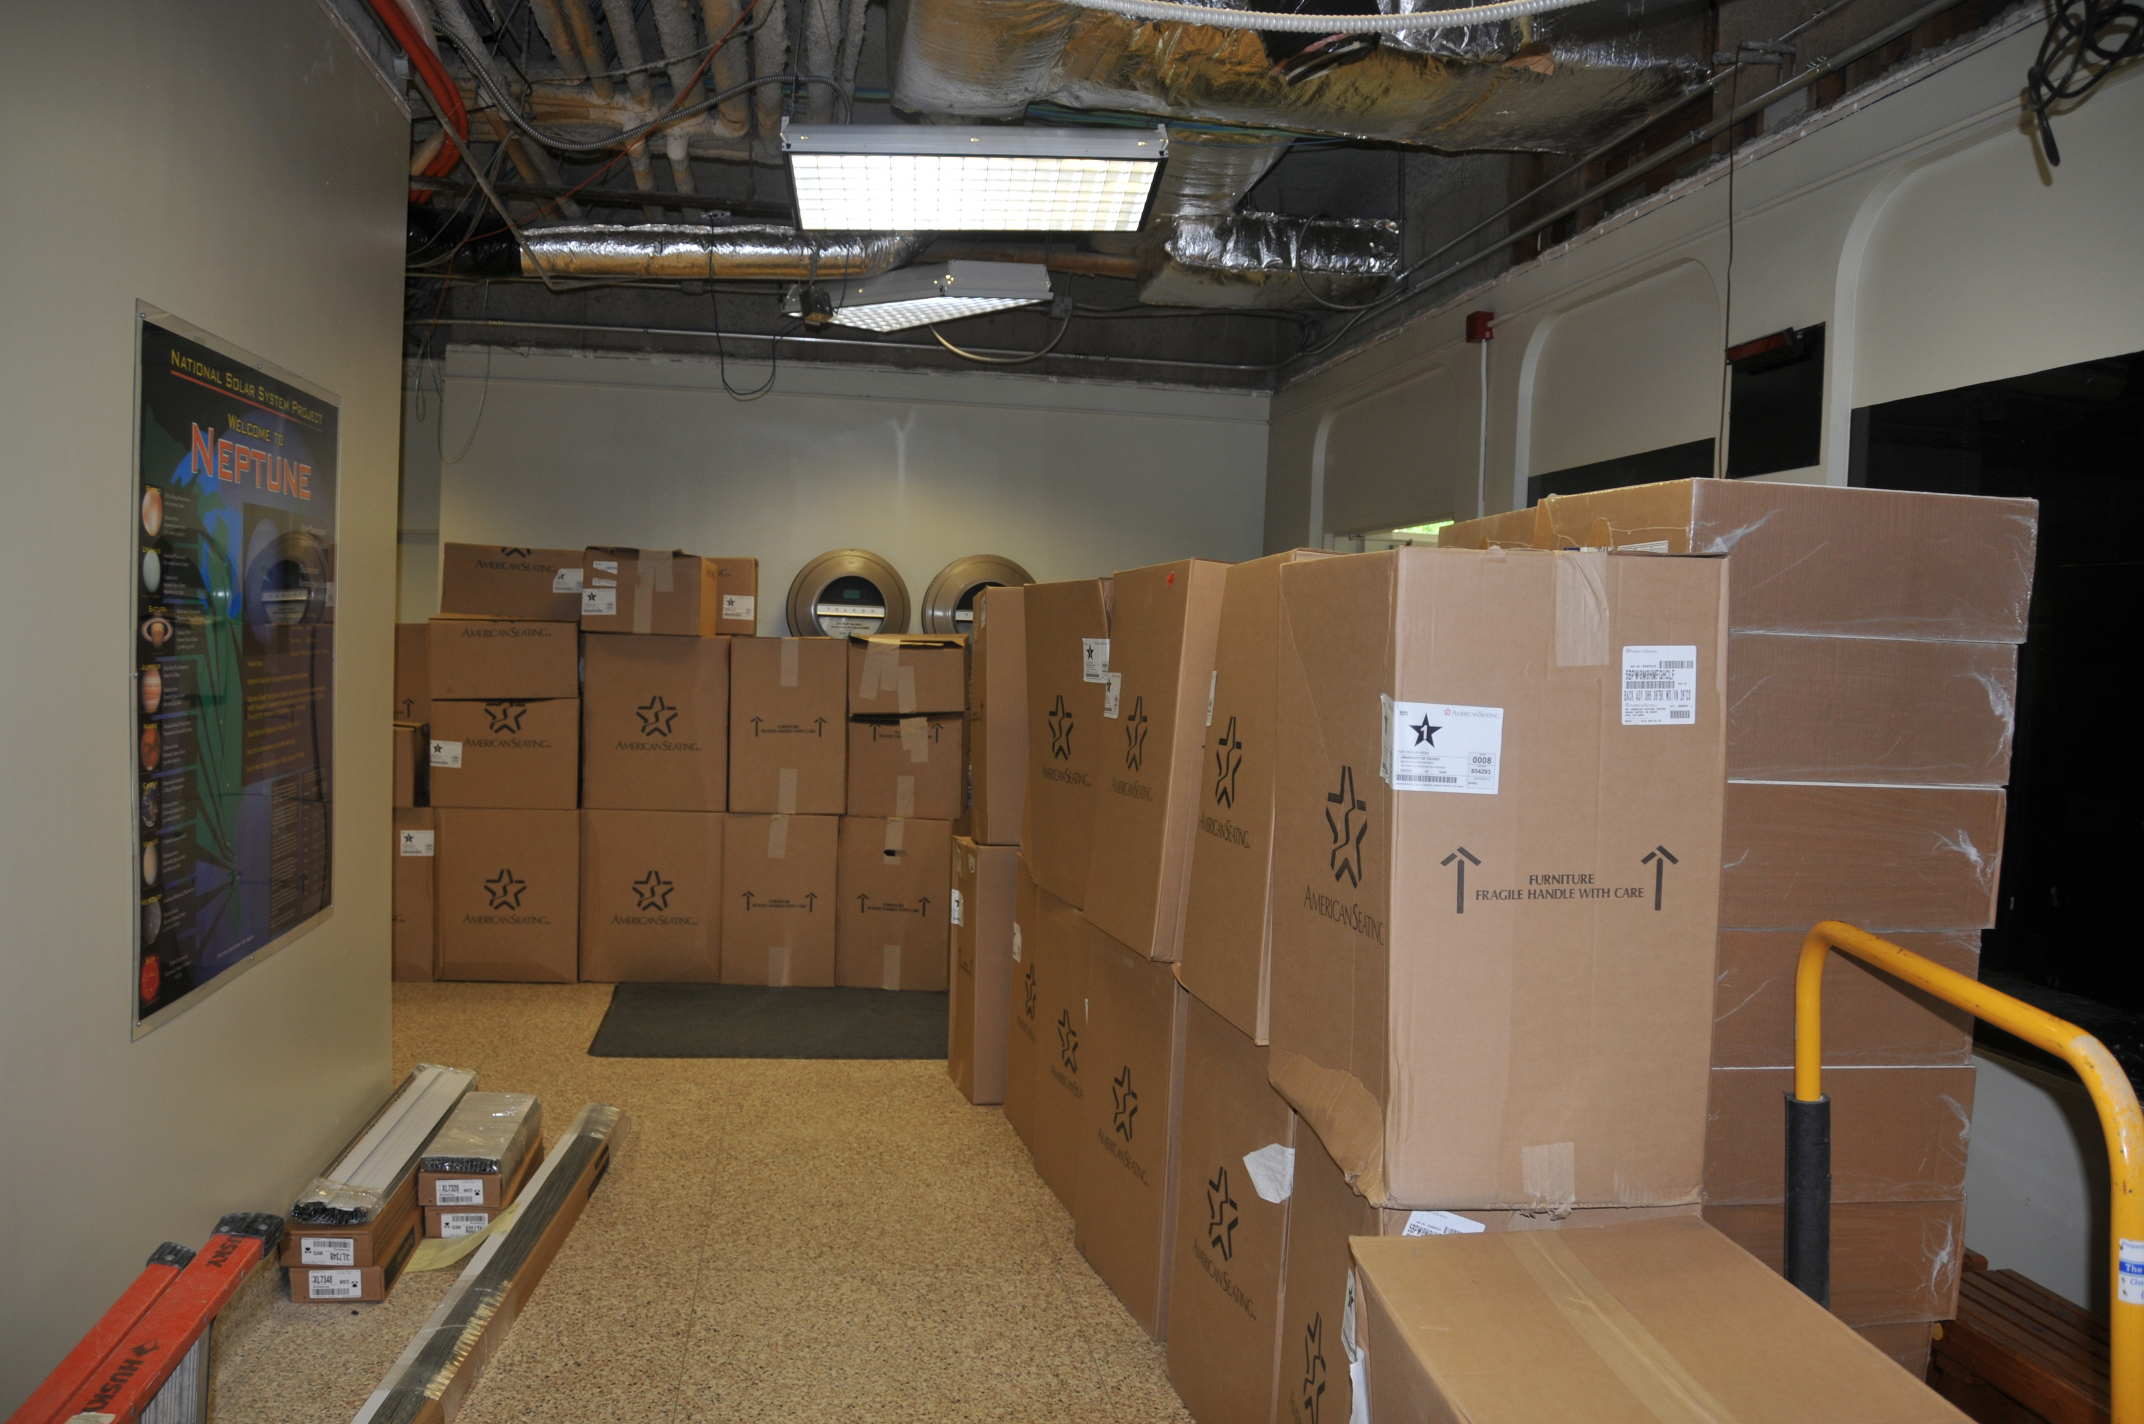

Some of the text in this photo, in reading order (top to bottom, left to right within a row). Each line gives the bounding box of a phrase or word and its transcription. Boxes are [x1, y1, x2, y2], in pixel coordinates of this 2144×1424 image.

[170, 349, 323, 425] NATIONAL SOLAR SYSTEM PROJECT
[227, 413, 272, 443] WELCOME
[191, 421, 313, 500] NEPTUNE
[1420, 725, 1428, 740] 1
[1472, 756, 1493, 766] 0008
[1529, 874, 1595, 885] FURNITURE
[1475, 887, 1645, 901] FRAGILE HANDLE WITH CARE
